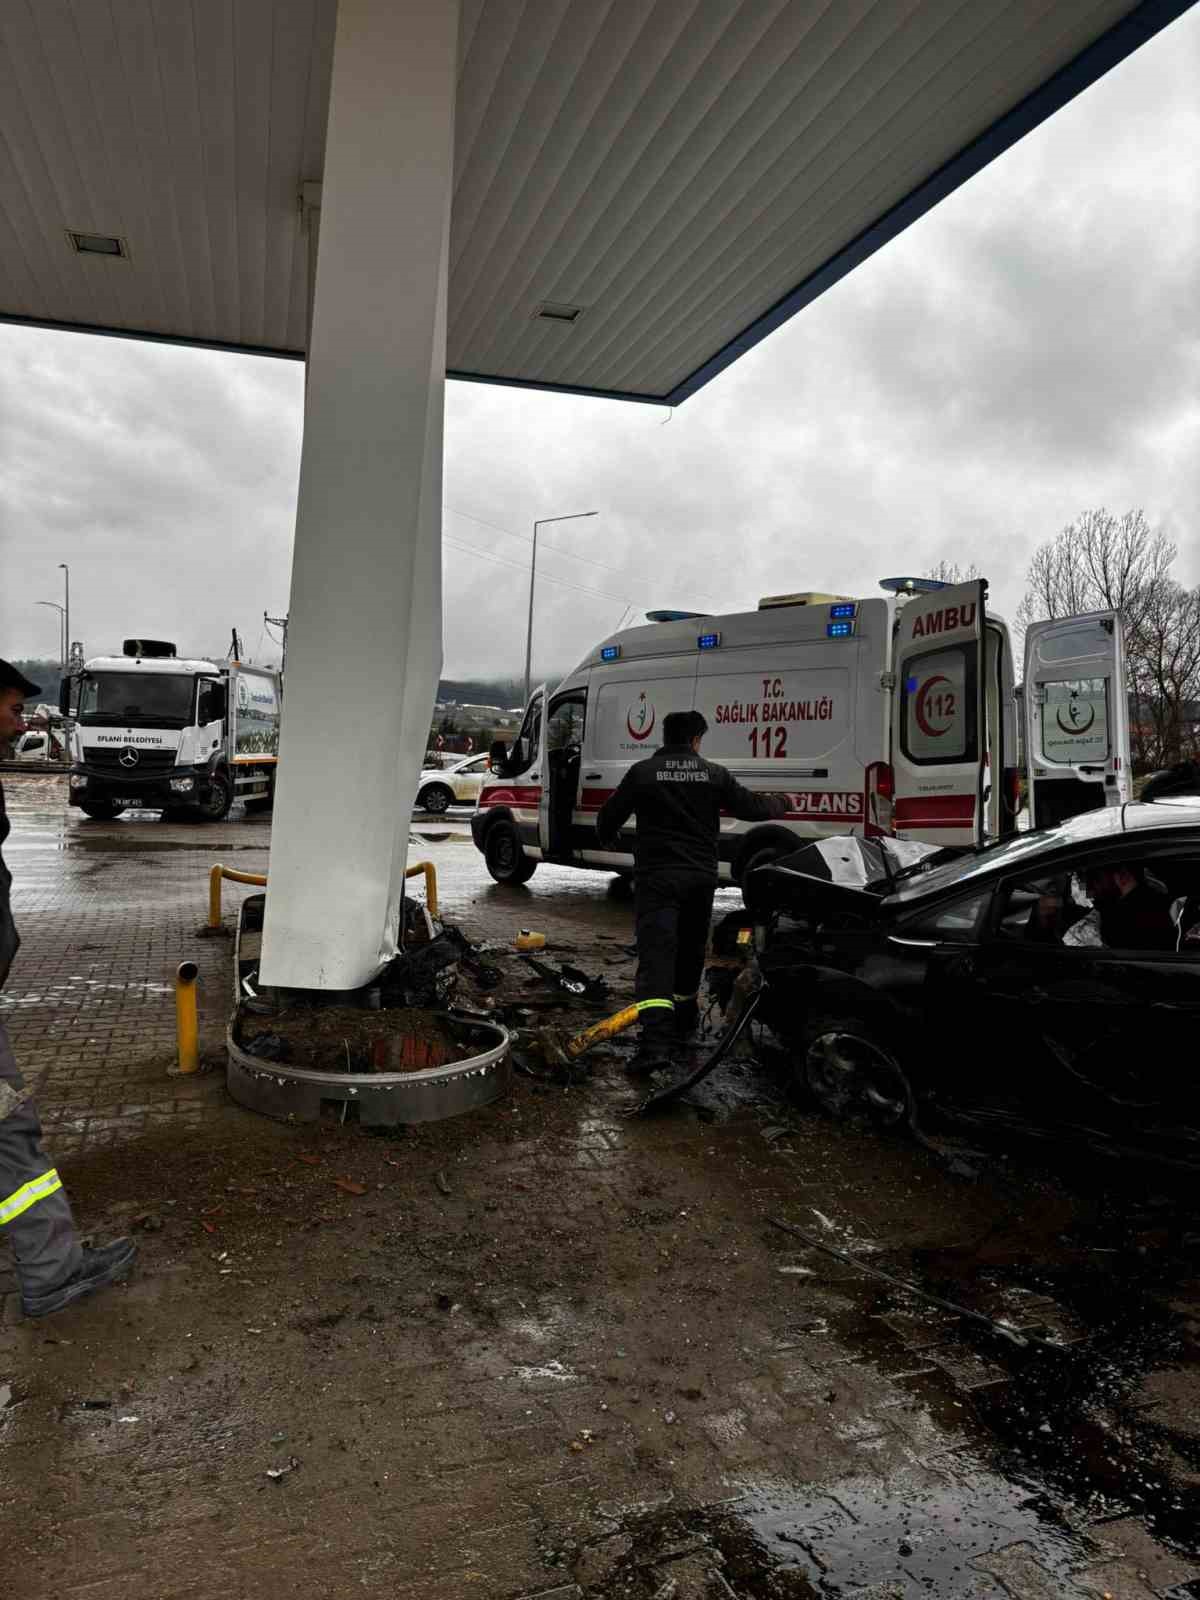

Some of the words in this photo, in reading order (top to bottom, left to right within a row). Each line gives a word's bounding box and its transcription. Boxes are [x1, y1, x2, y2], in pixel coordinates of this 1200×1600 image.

[912, 603, 976, 639] AMBU
[762, 678, 785, 698] T.C.
[715, 700, 759, 724] SAĞLIK
[925, 694, 955, 719] 112
[748, 726, 787, 758] 112
[755, 792, 861, 813] ULANS
